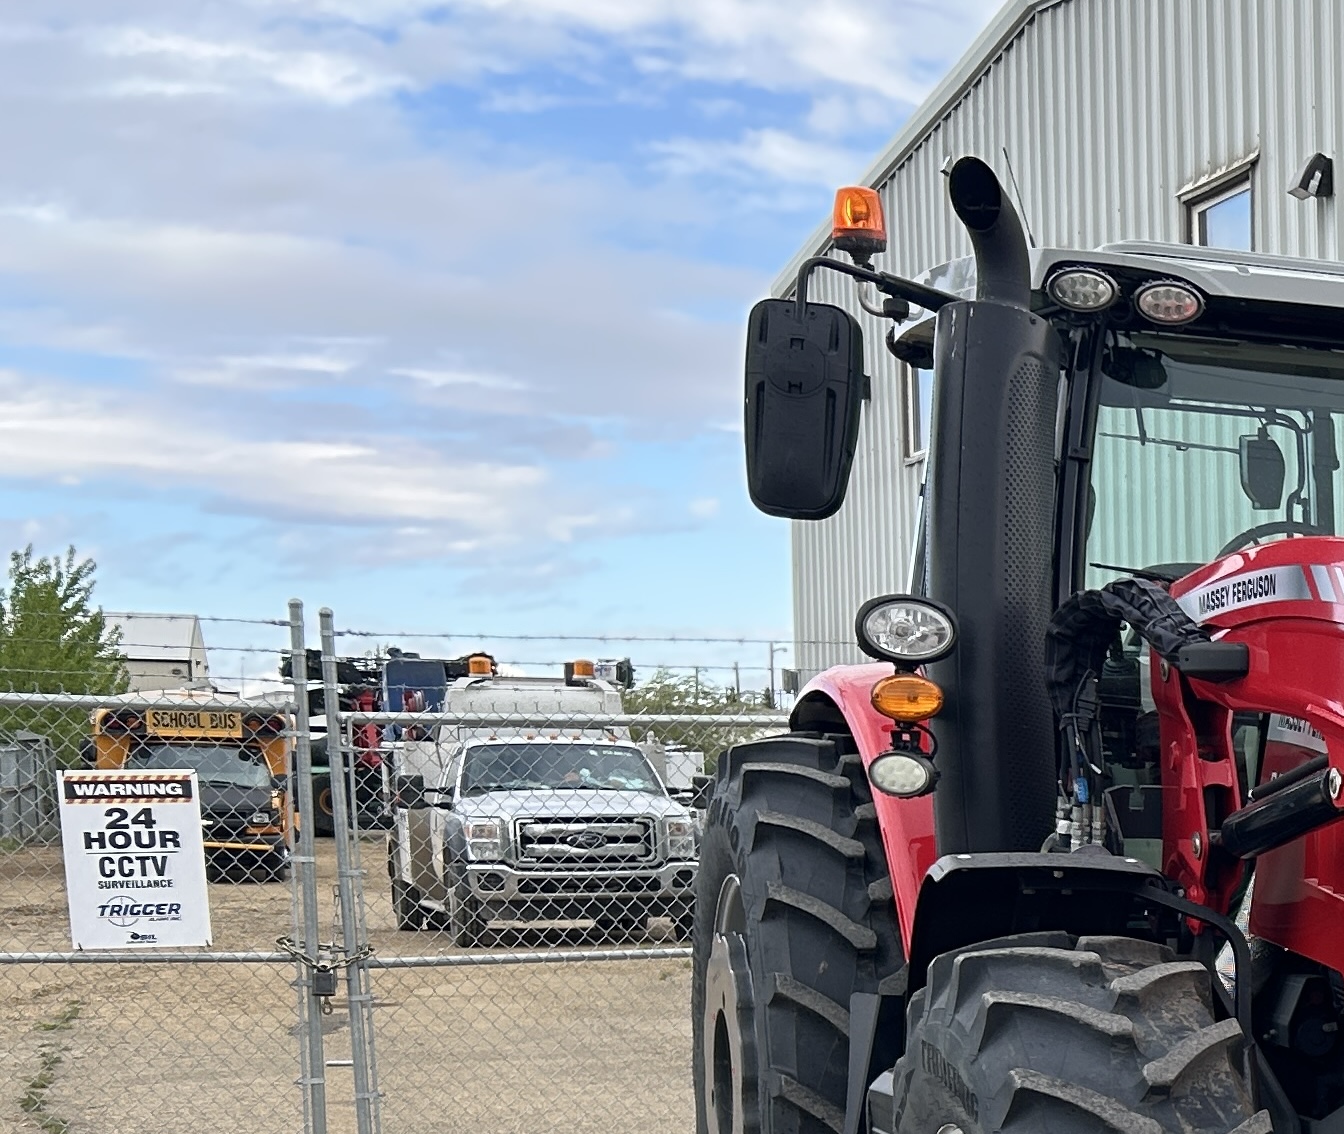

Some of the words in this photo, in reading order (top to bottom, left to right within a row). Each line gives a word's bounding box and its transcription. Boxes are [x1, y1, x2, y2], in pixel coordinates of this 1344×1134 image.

[1199, 584, 1230, 615] MASSEY
[1232, 574, 1277, 603] FERGUSON
[152, 711, 204, 729] SCHOOL
[210, 712, 236, 730] BUS
[73, 783, 183, 796] WARNING
[104, 808, 157, 829] 24
[83, 830, 181, 850] HOUR
[99, 855, 168, 878] CCTV
[97, 879, 174, 889] SURVEILLANCE
[98, 903, 182, 917] TRIGGER
